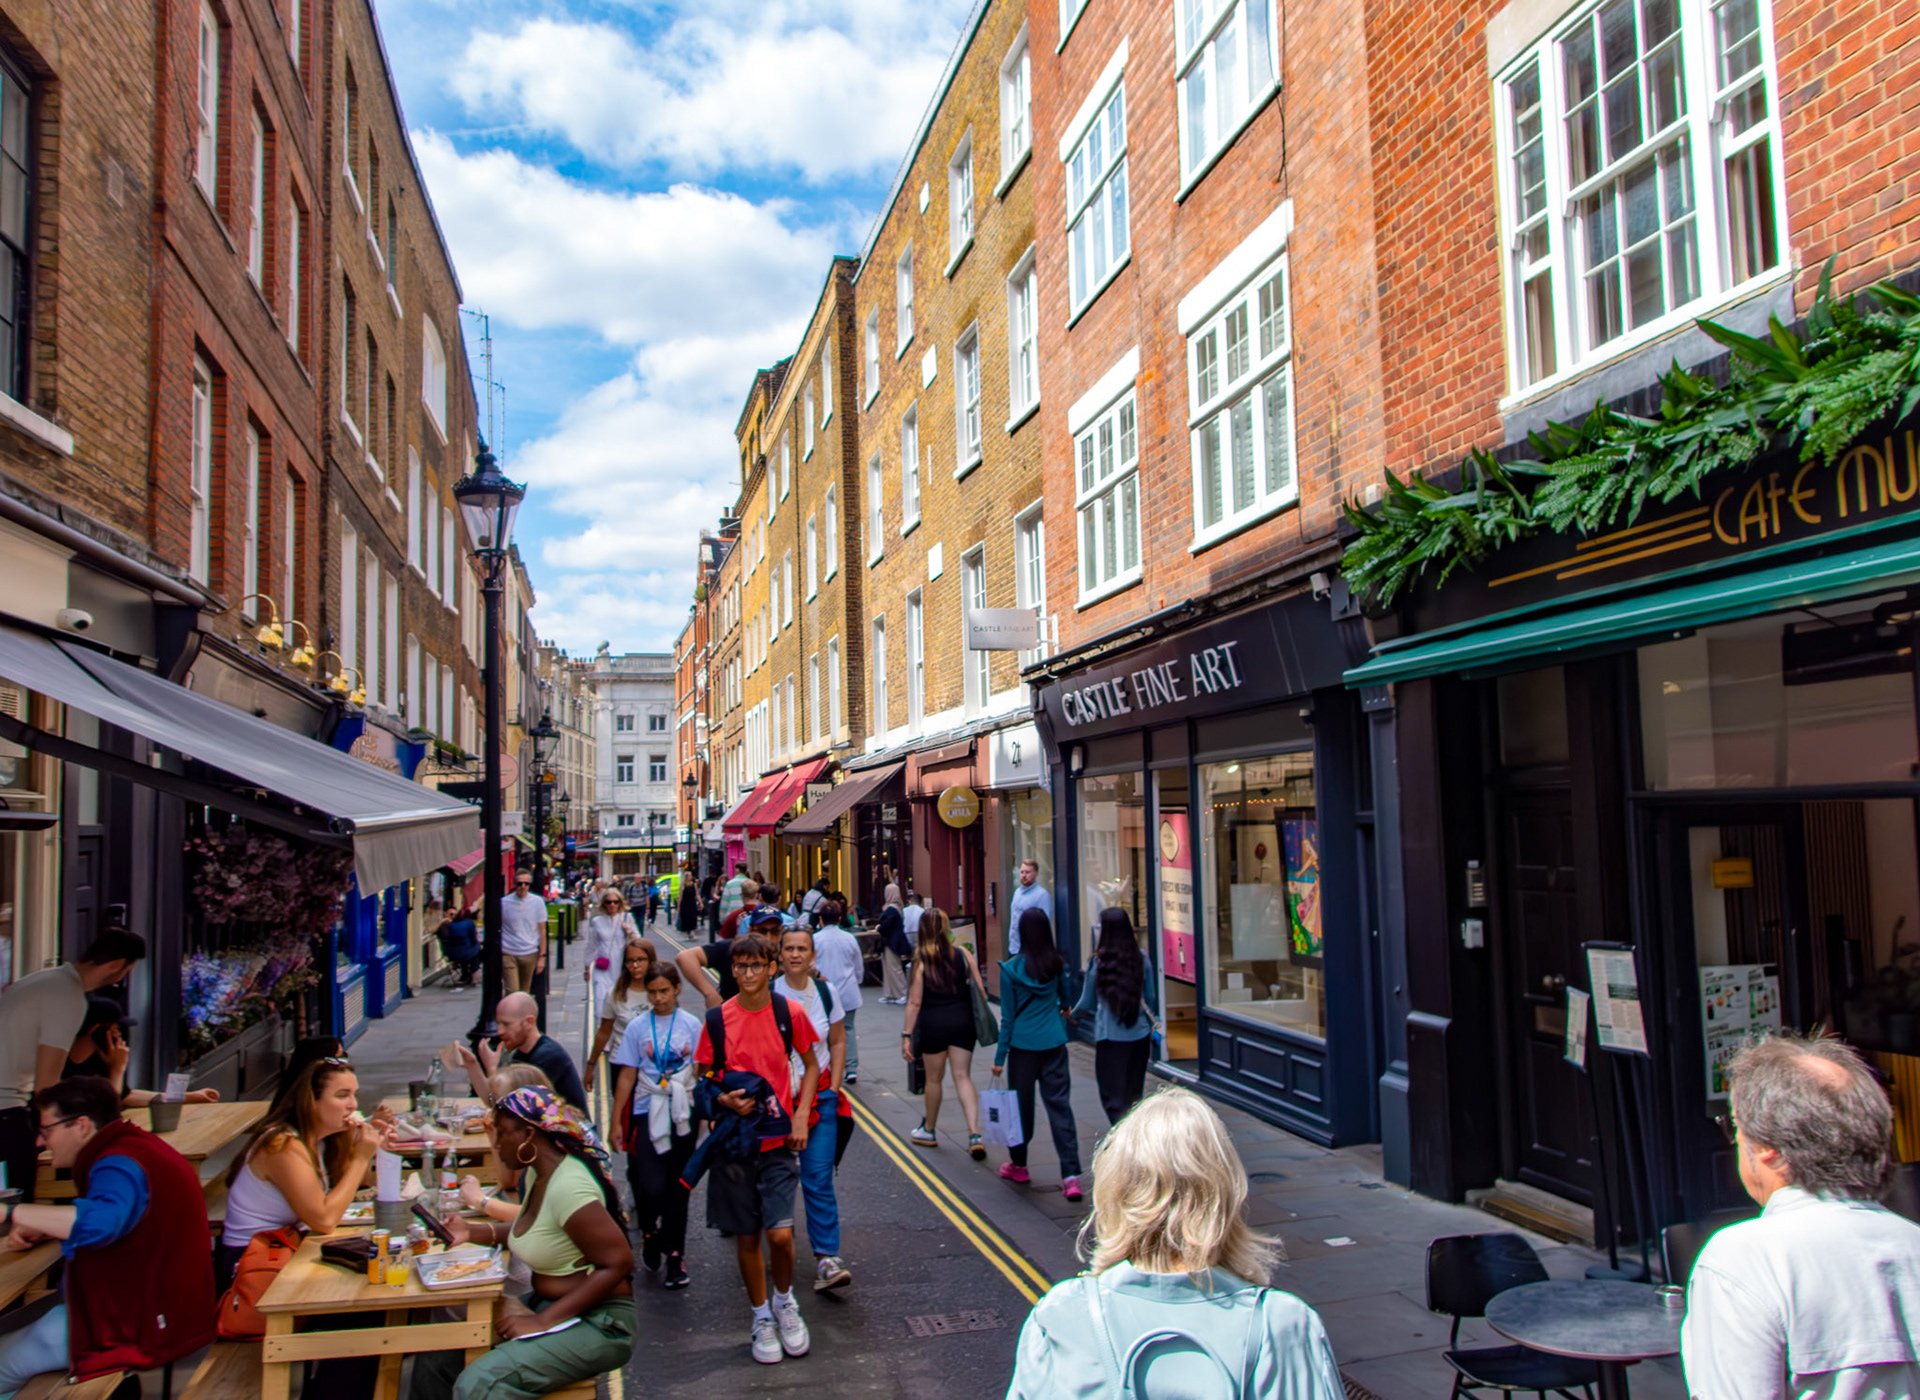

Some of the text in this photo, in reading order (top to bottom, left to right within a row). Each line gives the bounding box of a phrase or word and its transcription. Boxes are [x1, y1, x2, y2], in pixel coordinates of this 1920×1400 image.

[1714, 430, 1920, 544] CAFE MU
[973, 625, 1001, 633] CASTLE
[1003, 625, 1020, 633] FINE
[1061, 640, 1242, 726] CASTLE FINE ART
